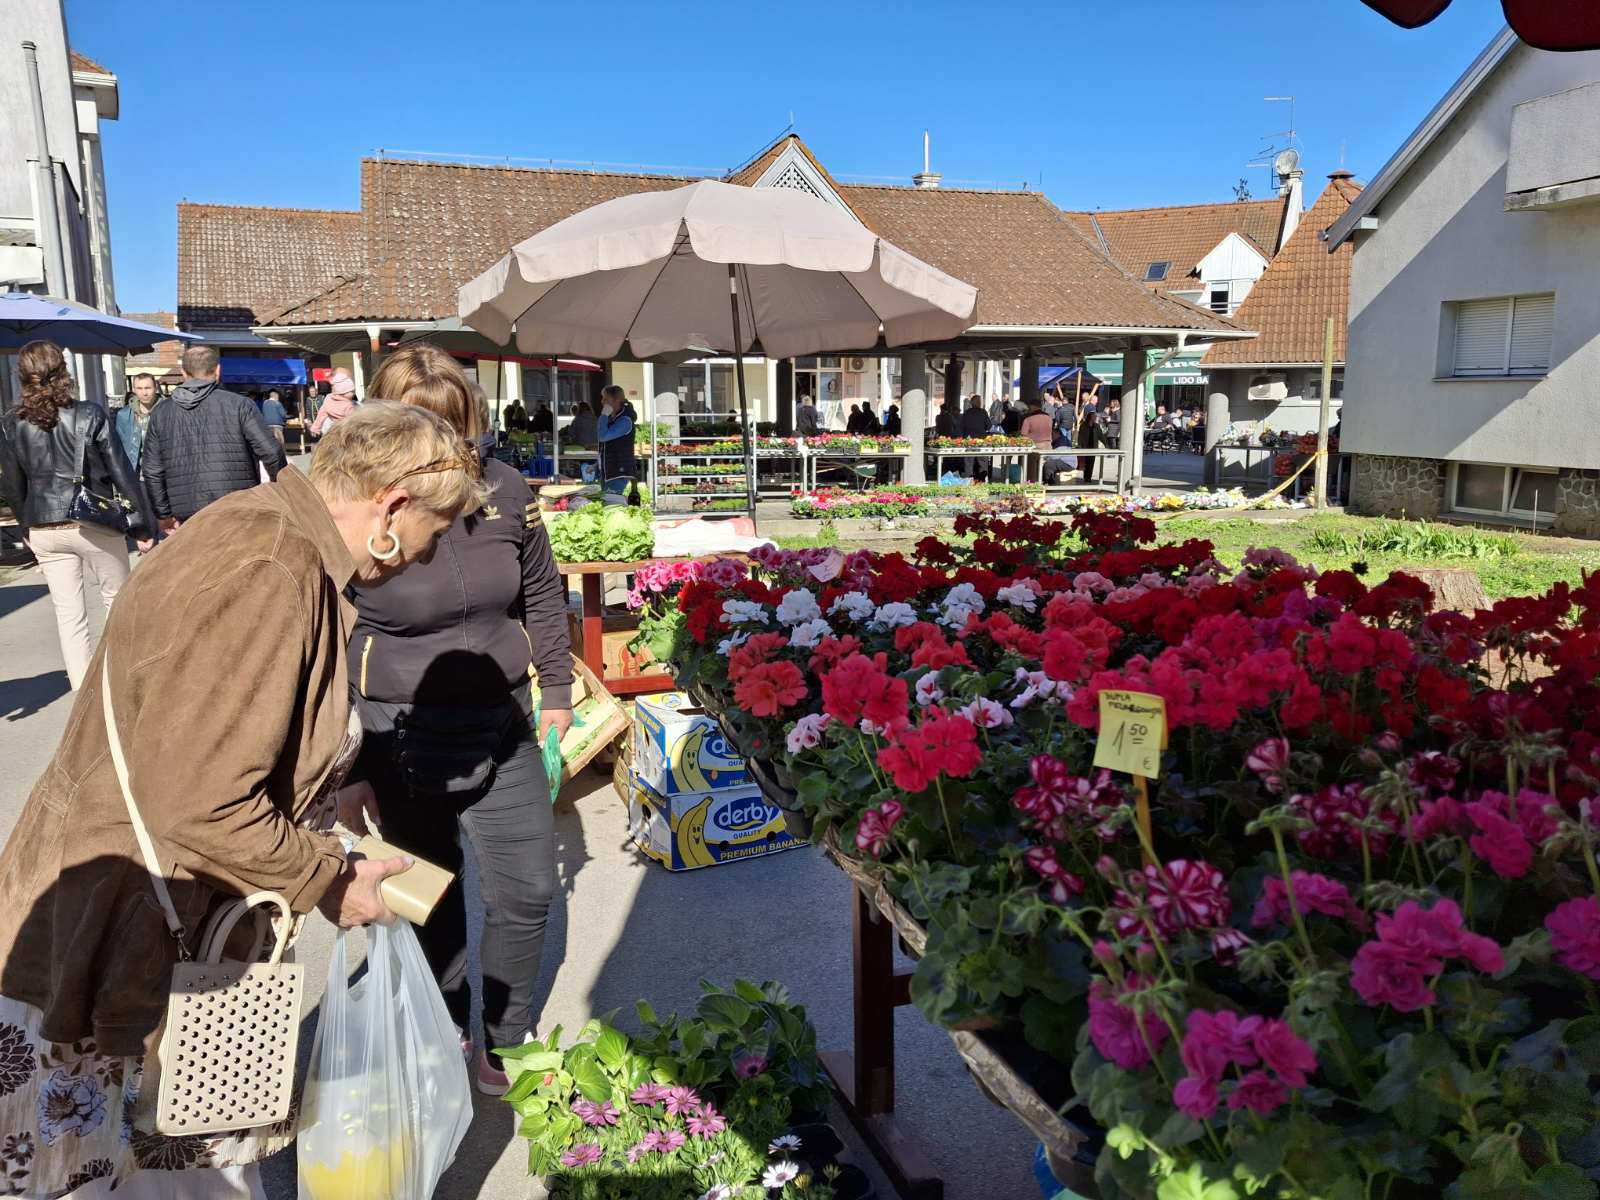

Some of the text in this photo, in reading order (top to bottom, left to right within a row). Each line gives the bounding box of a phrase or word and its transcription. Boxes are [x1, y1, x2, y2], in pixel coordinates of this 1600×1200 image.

[1173, 376, 1195, 385] LIDO
[718, 801, 773, 826] derby
[733, 828, 762, 840] QUALITY
[720, 844, 767, 860] PREMIUM
